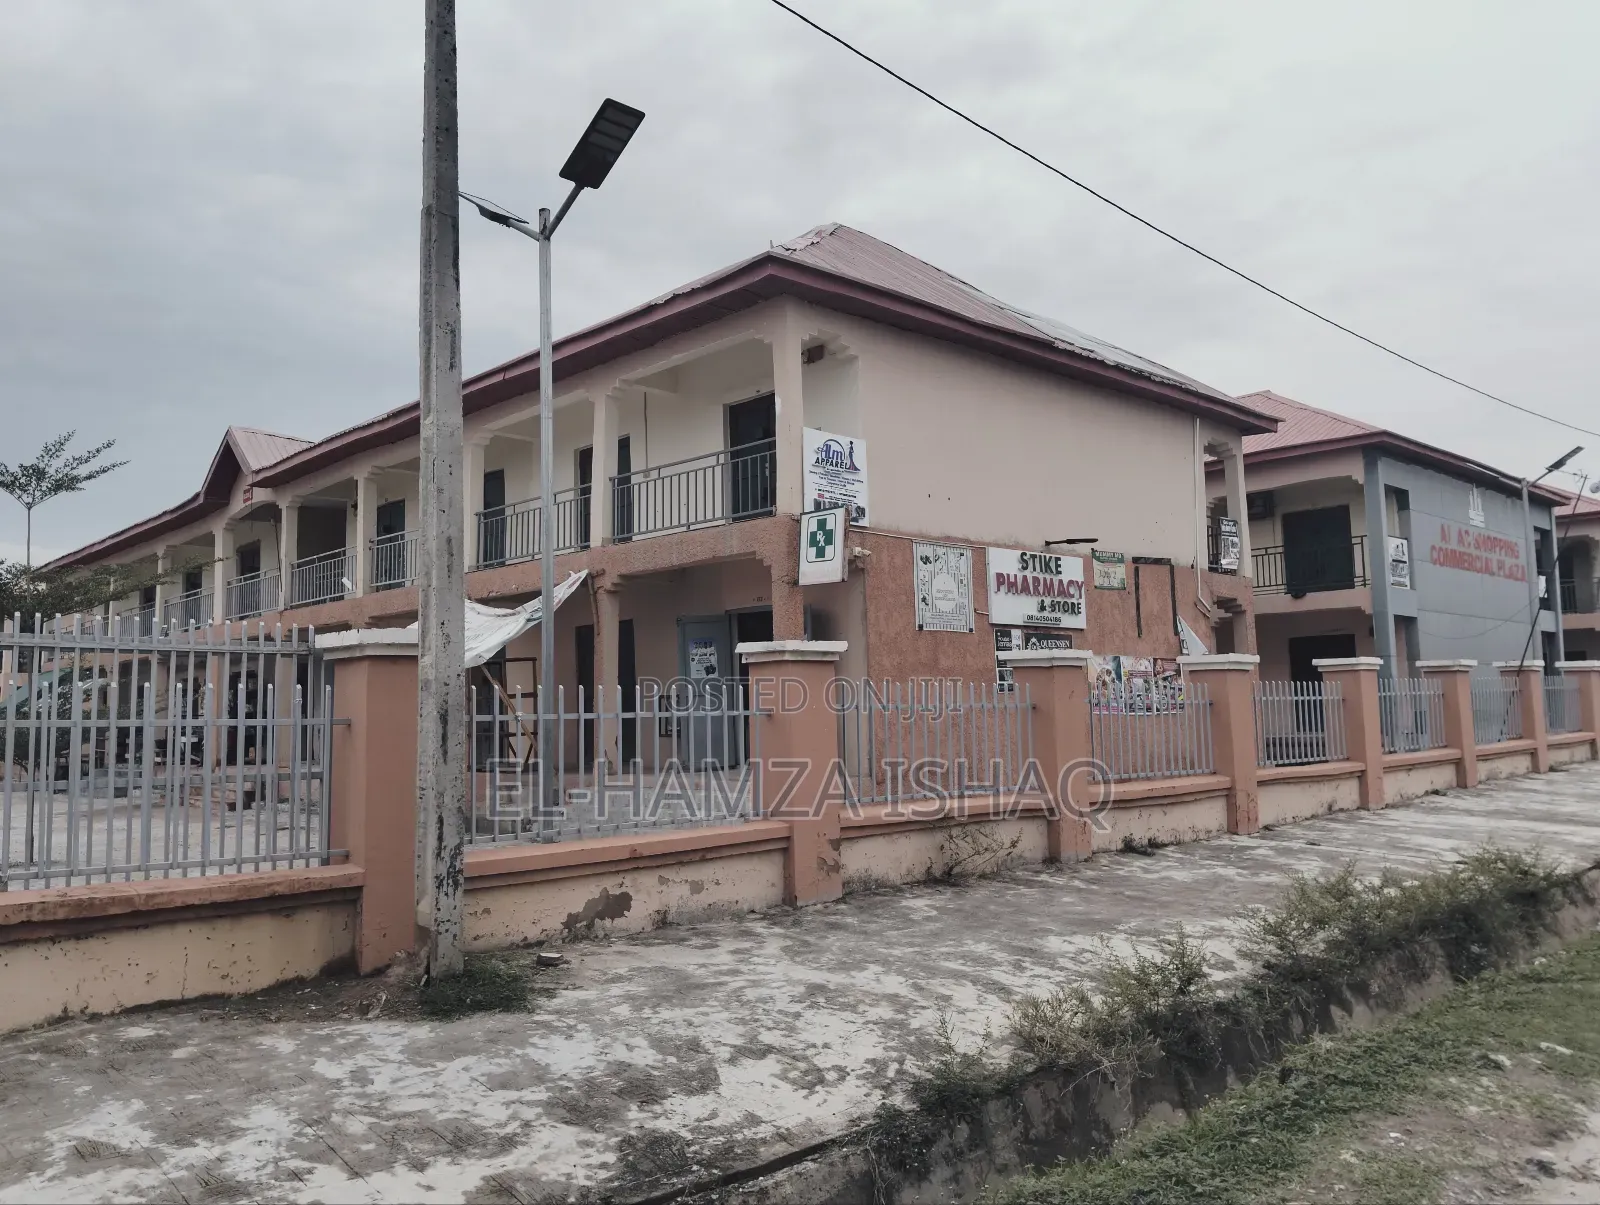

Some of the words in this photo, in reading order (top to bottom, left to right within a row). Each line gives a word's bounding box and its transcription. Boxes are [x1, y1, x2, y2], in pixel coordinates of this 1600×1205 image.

[815, 457, 849, 470] APPAREL
[1020, 552, 1062, 575] STIKE
[1430, 545, 1495, 576] COMMERCIAL
[995, 572, 1084, 599] PHARMACY
[1039, 599, 1046, 612] &
[1049, 600, 1081, 615] STORE
[1040, 639, 1070, 649] QUEENSEN
